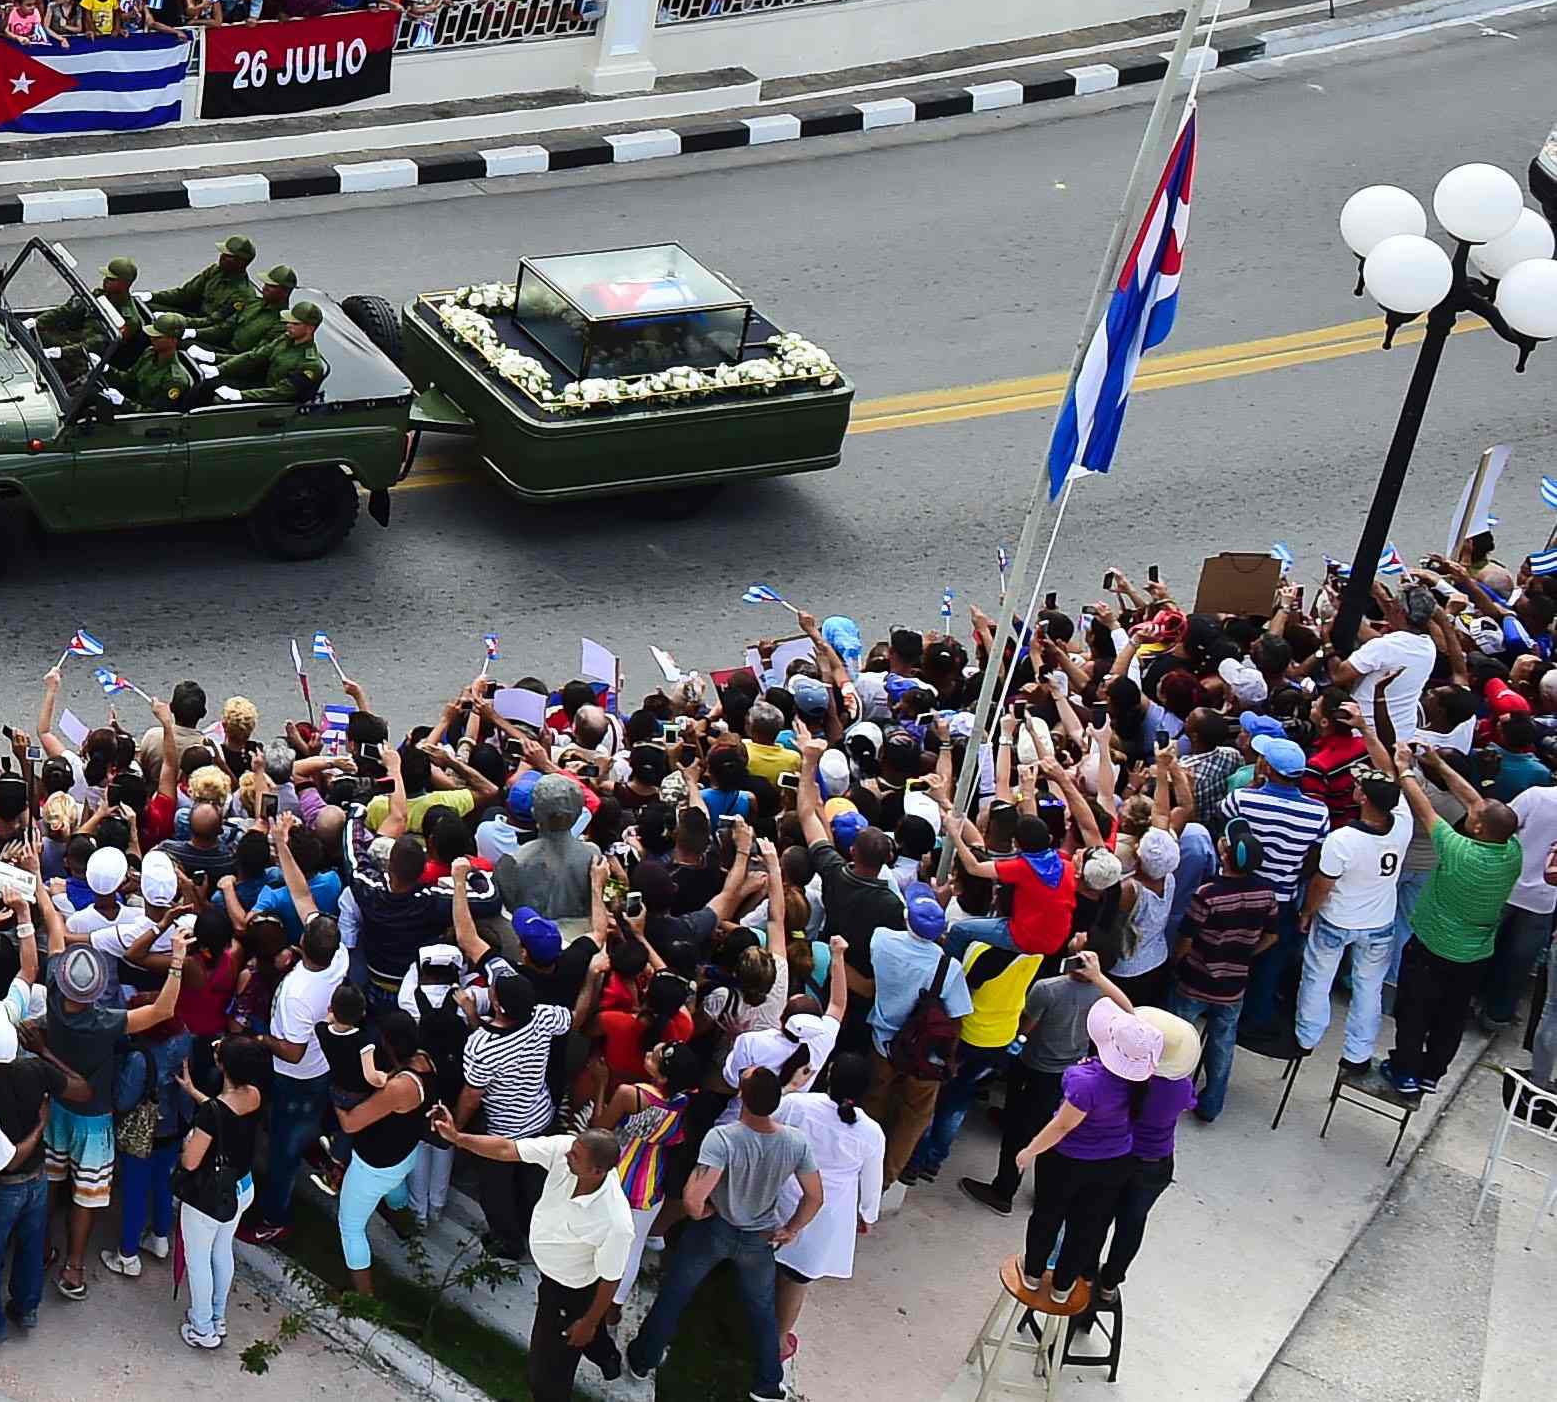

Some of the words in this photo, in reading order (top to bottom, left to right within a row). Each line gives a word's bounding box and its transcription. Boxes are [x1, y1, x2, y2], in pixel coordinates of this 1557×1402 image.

[232, 49, 268, 90] 26
[276, 37, 368, 86] JULIO
[1380, 852, 1398, 877] 9
